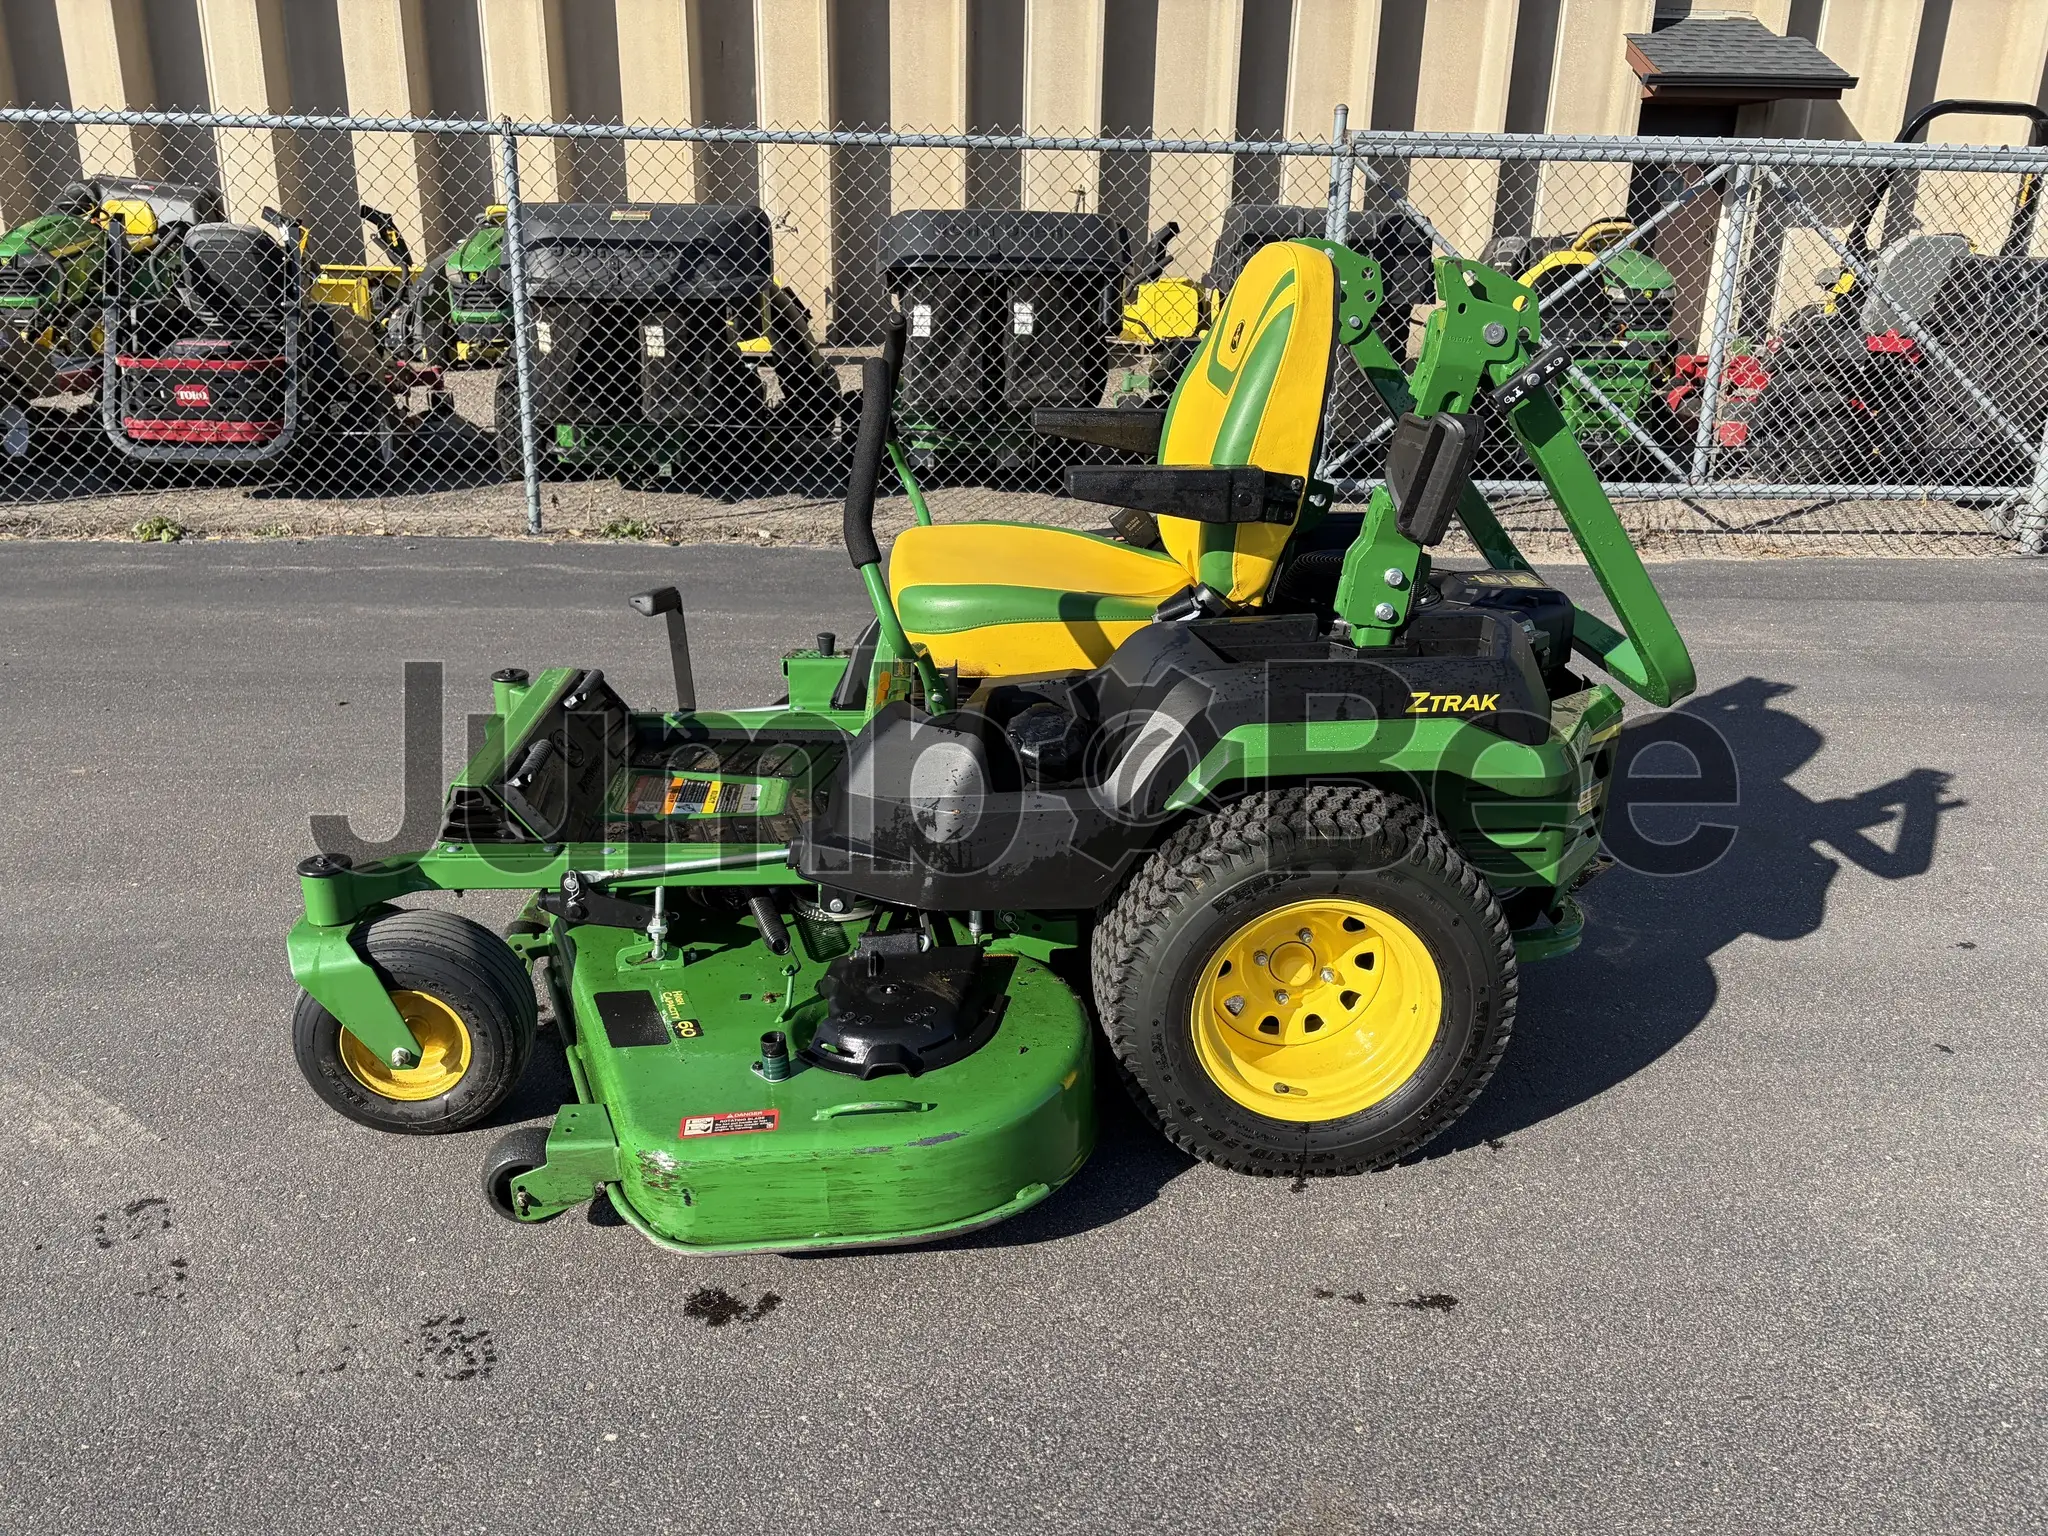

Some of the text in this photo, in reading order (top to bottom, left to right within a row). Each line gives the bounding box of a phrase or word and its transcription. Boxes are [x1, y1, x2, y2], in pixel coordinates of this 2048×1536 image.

[1405, 692, 1500, 713] ZTRAK
[662, 991, 681, 1020] CAPACITY
[672, 990, 685, 1006] HIGH
[677, 1020, 697, 1038] 60
